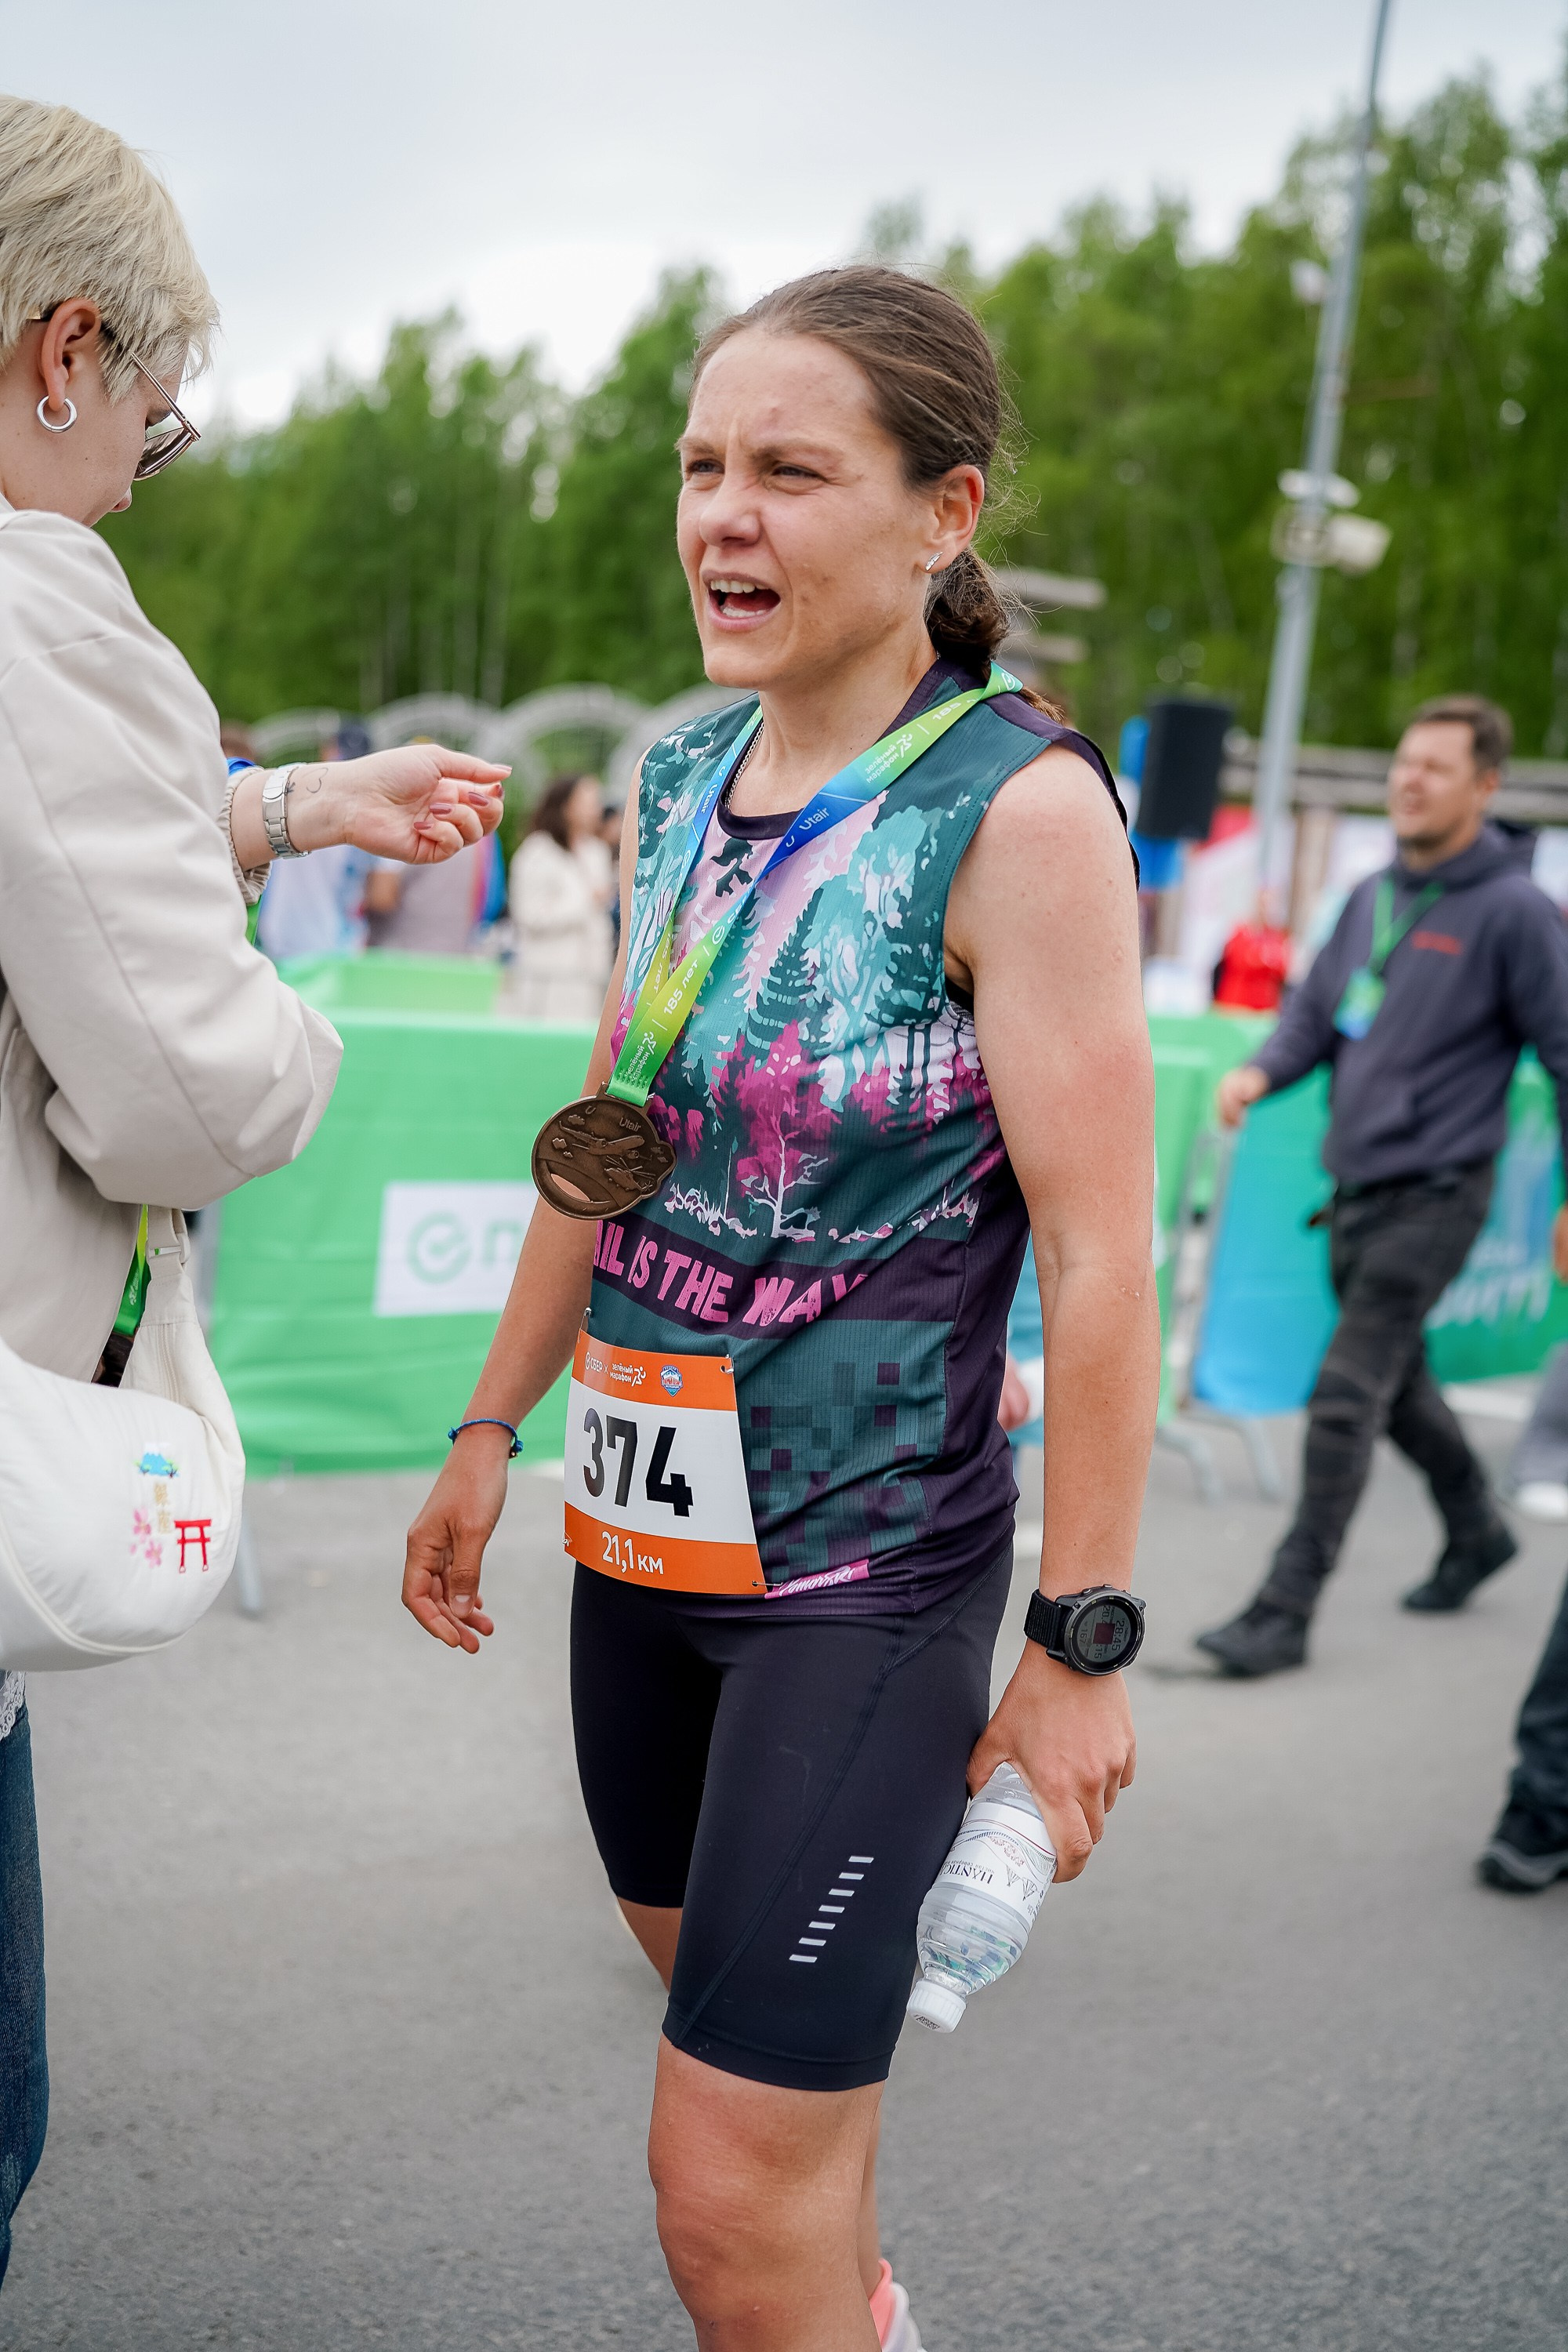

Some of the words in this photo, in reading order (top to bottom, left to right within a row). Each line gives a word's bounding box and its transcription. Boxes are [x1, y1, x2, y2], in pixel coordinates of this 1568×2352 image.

[865, 744, 897, 774] зелёный
[866, 751, 900, 785] марафон
[701, 783, 718, 814] Utair
[799, 807, 830, 831] Utair
[681, 960, 699, 988] лет
[663, 988, 684, 1015] 185
[619, 1116, 641, 1131] Utair
[627, 1235, 659, 1289] IS
[657, 1249, 734, 1323] THE
[590, 1357, 603, 1373] СБЕР
[612, 1363, 633, 1374] зелёный
[610, 1372, 632, 1383] марафон
[583, 1408, 694, 1518] 374
[602, 1531, 635, 1573] 21,1
